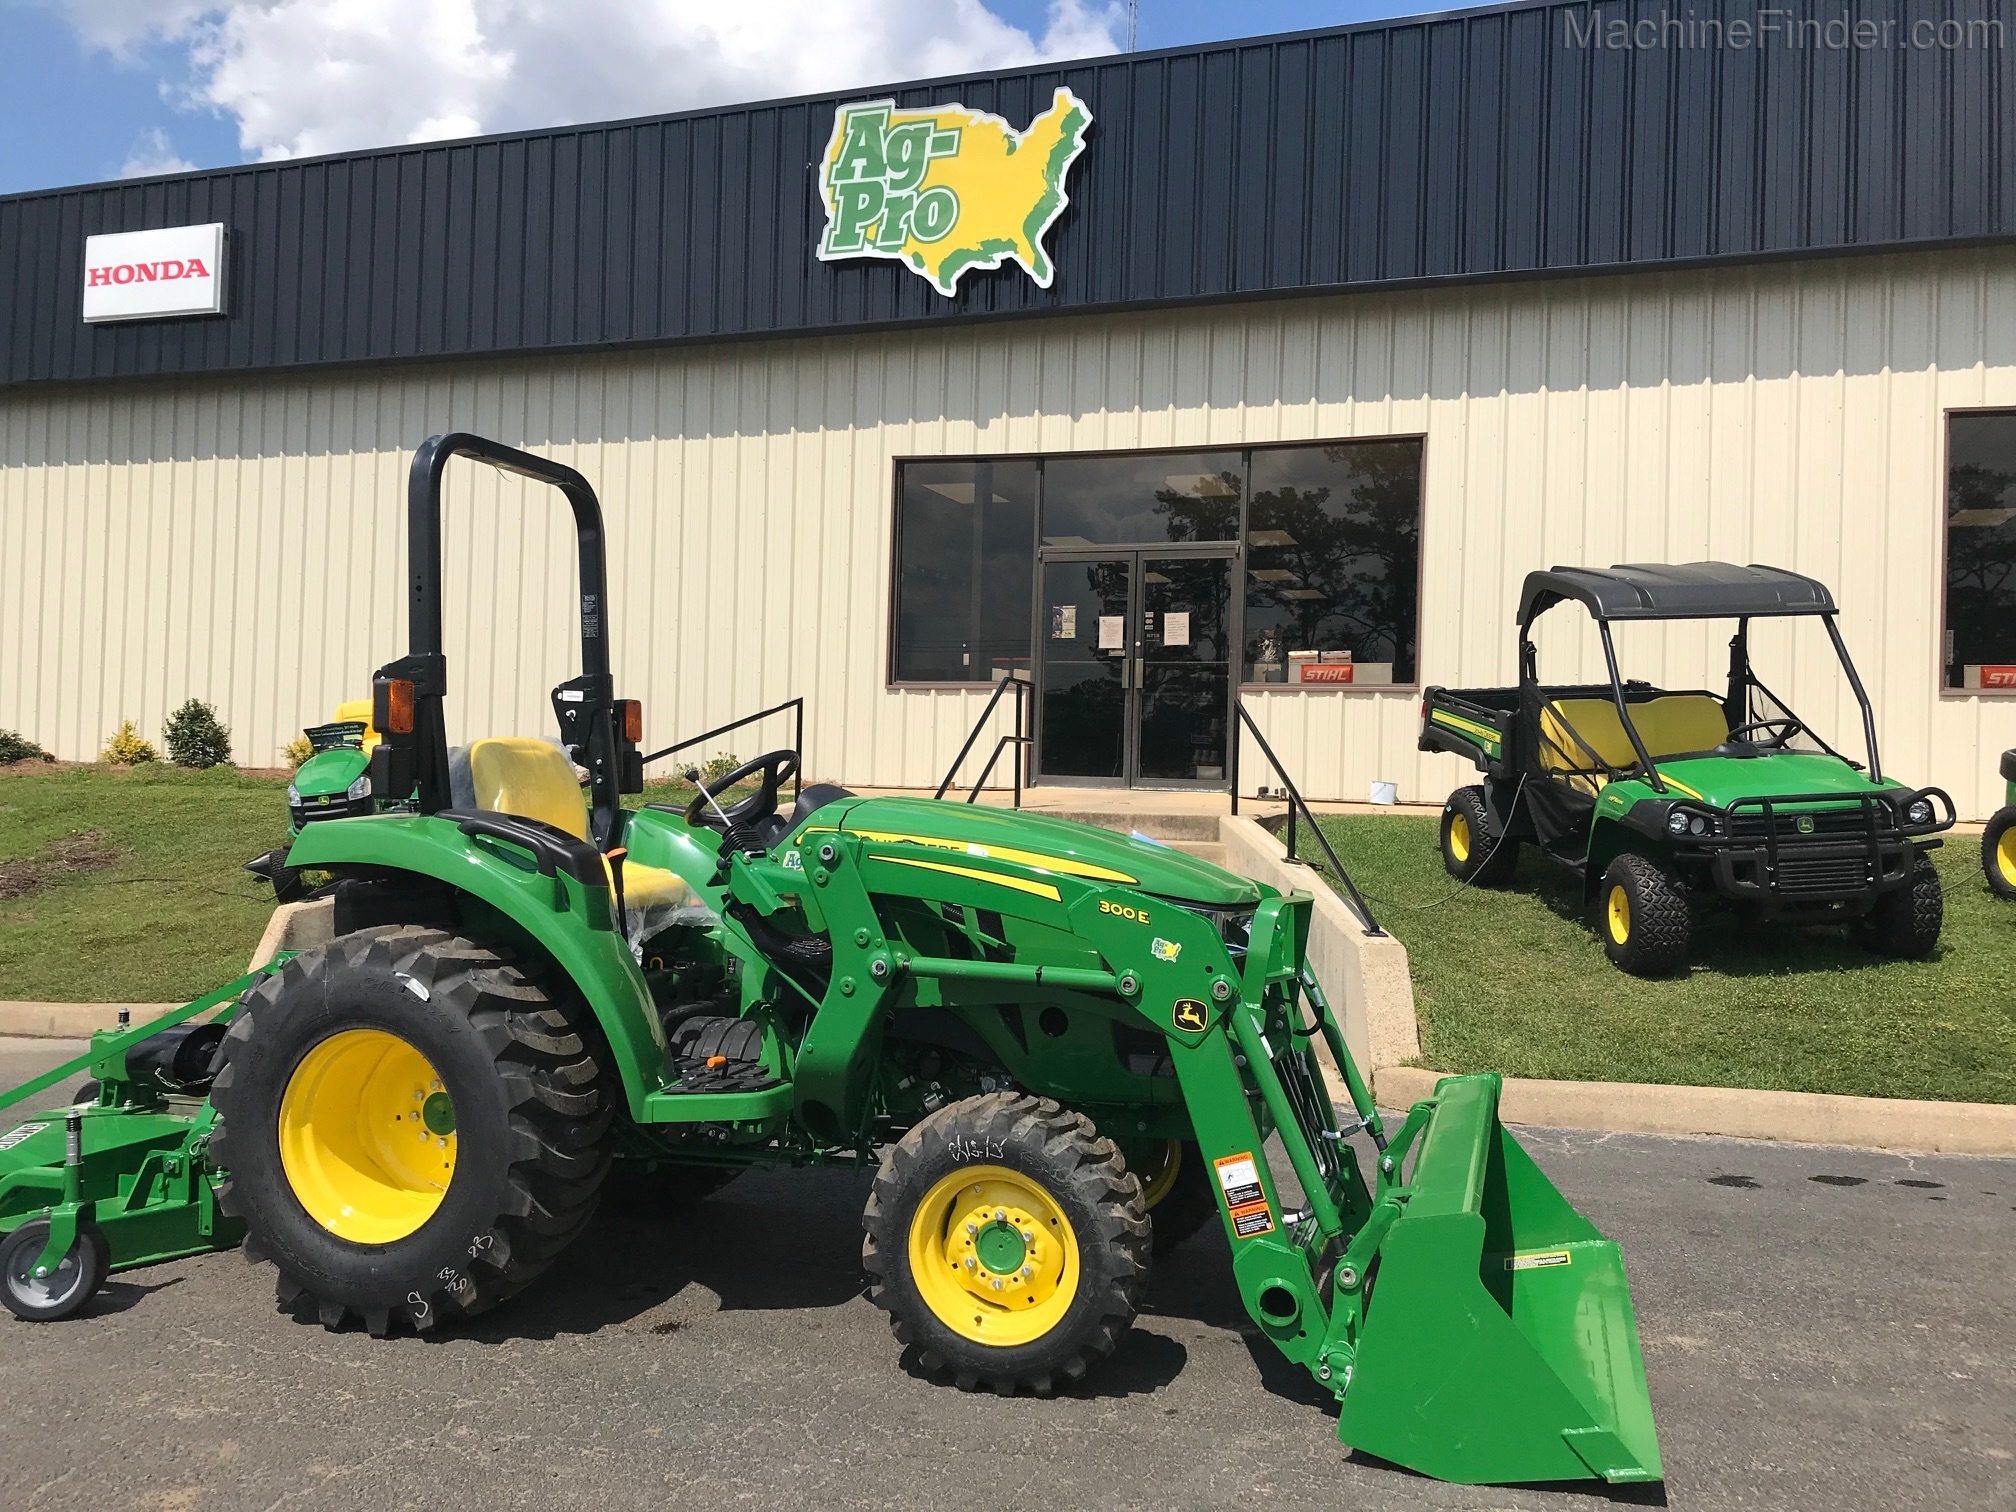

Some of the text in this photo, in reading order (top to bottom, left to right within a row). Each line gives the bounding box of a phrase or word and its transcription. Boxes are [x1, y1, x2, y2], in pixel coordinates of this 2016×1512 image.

[828, 106, 962, 192] Ag-
[825, 178, 959, 253] Pro
[88, 258, 210, 287] HONDA
[1304, 670, 1347, 681] STIHL
[1225, 1155, 1249, 1165] WARNING
[1241, 1205, 1265, 1215] WARNING
